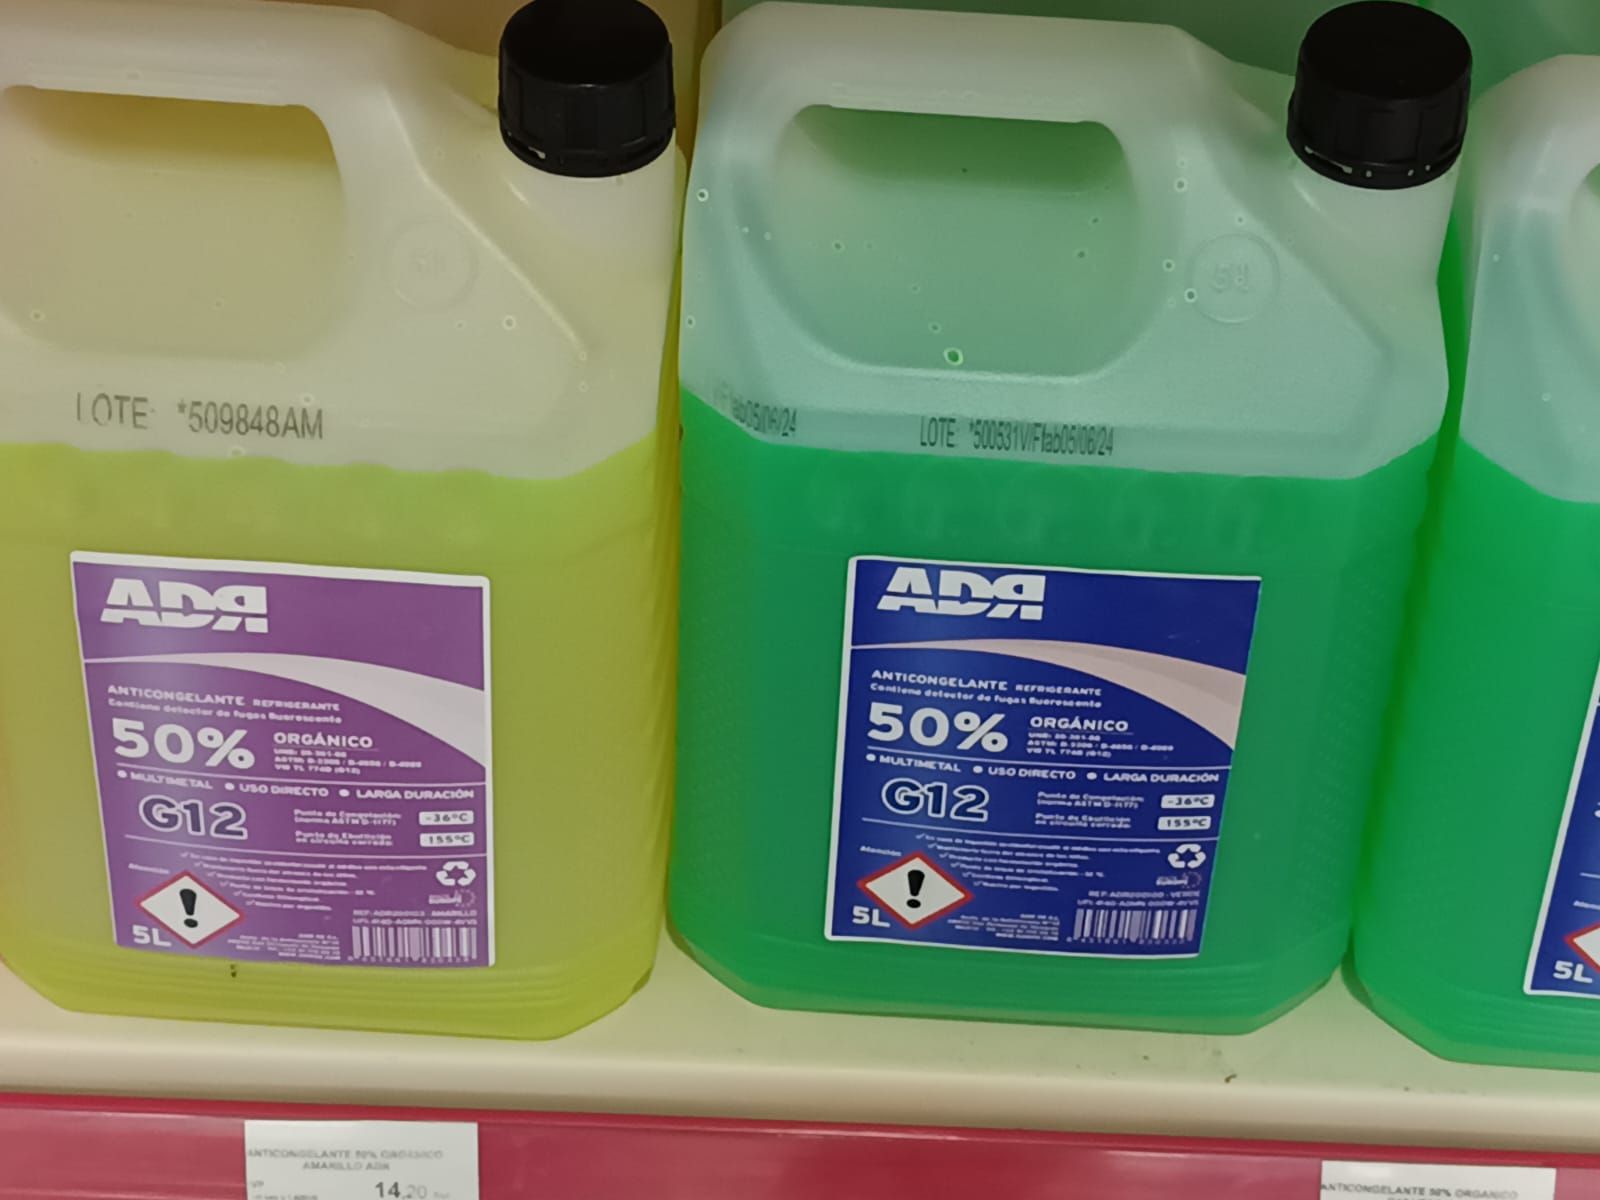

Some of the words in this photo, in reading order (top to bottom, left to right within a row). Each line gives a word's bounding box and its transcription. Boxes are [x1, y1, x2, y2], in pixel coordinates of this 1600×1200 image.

[871, 669, 1008, 691] ANTICONGELANTE
[1015, 684, 1103, 696] REFRIGERANTE
[107, 685, 246, 706] ANTICONGELANTE
[253, 699, 340, 711] REFRIGERANTE
[977, 694, 991, 702] de
[867, 701, 1009, 752] 50%
[1030, 716, 1129, 732] ORGÁNICO
[112, 717, 255, 769] 50%
[273, 732, 373, 748] ORGÁNICO
[879, 754, 961, 773] MULTIMETAL
[988, 766, 1016, 776] USO
[1018, 768, 1076, 780] DIRECTO
[1103, 772, 1147, 783] LARGA
[1150, 772, 1219, 784] DURACIÓN
[131, 772, 213, 790] MULTIMETAL
[239, 783, 269, 794] USO
[271, 785, 328, 797] DIRECTO
[356, 789, 401, 799] LARGA
[404, 788, 474, 800] DURACIÓN
[881, 777, 990, 823] G12
[139, 794, 248, 840] G12
[852, 905, 891, 928] 5L
[132, 924, 172, 947] 5L
[1553, 959, 1593, 984] 5L
